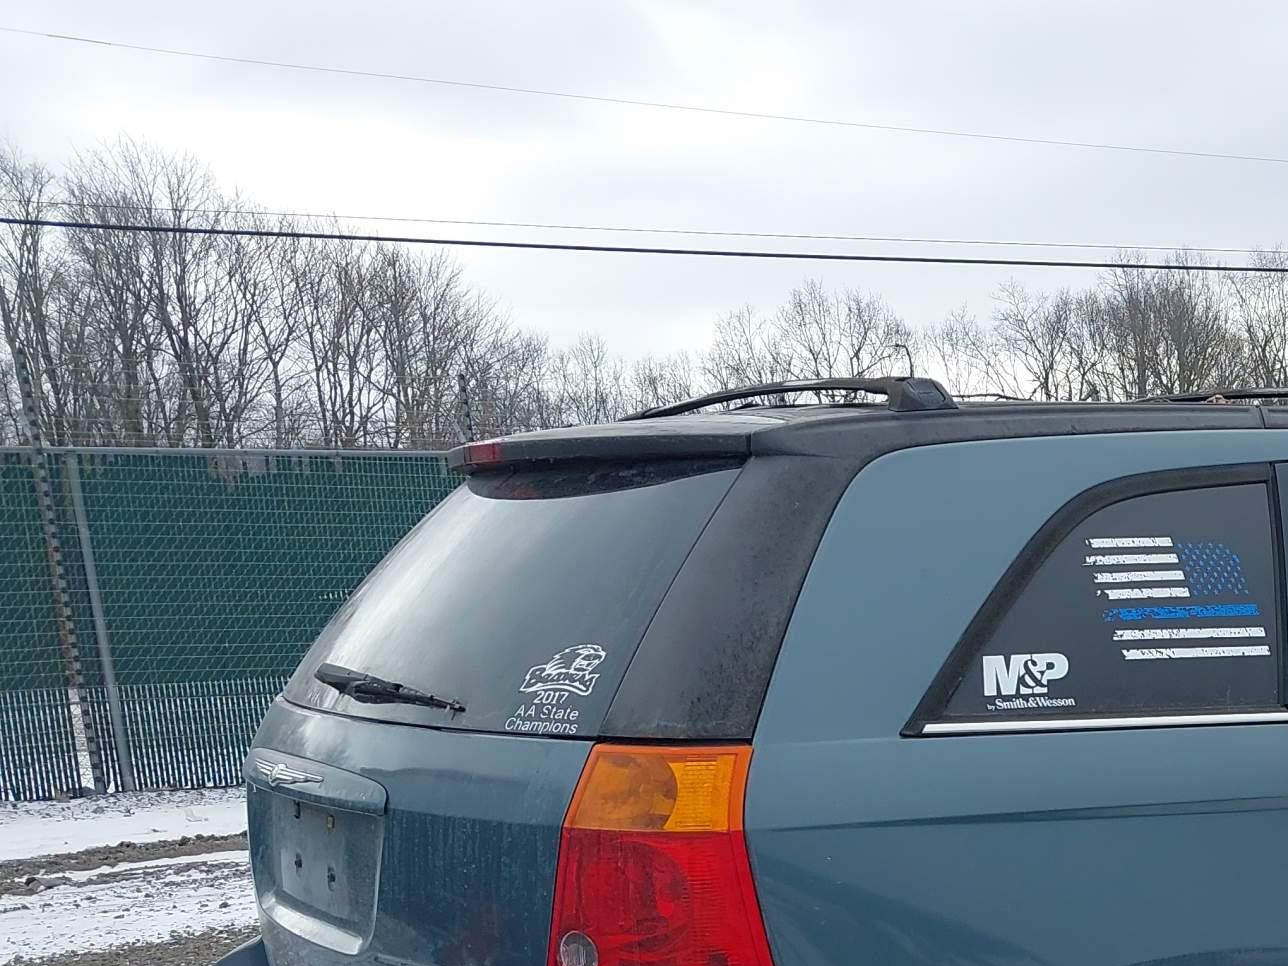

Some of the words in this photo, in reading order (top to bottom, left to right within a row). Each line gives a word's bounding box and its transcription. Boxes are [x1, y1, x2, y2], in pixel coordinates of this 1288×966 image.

[982, 652, 1069, 696] M&P
[533, 690, 569, 704] 2017
[540, 704, 579, 721] State
[505, 717, 578, 734] Champions
